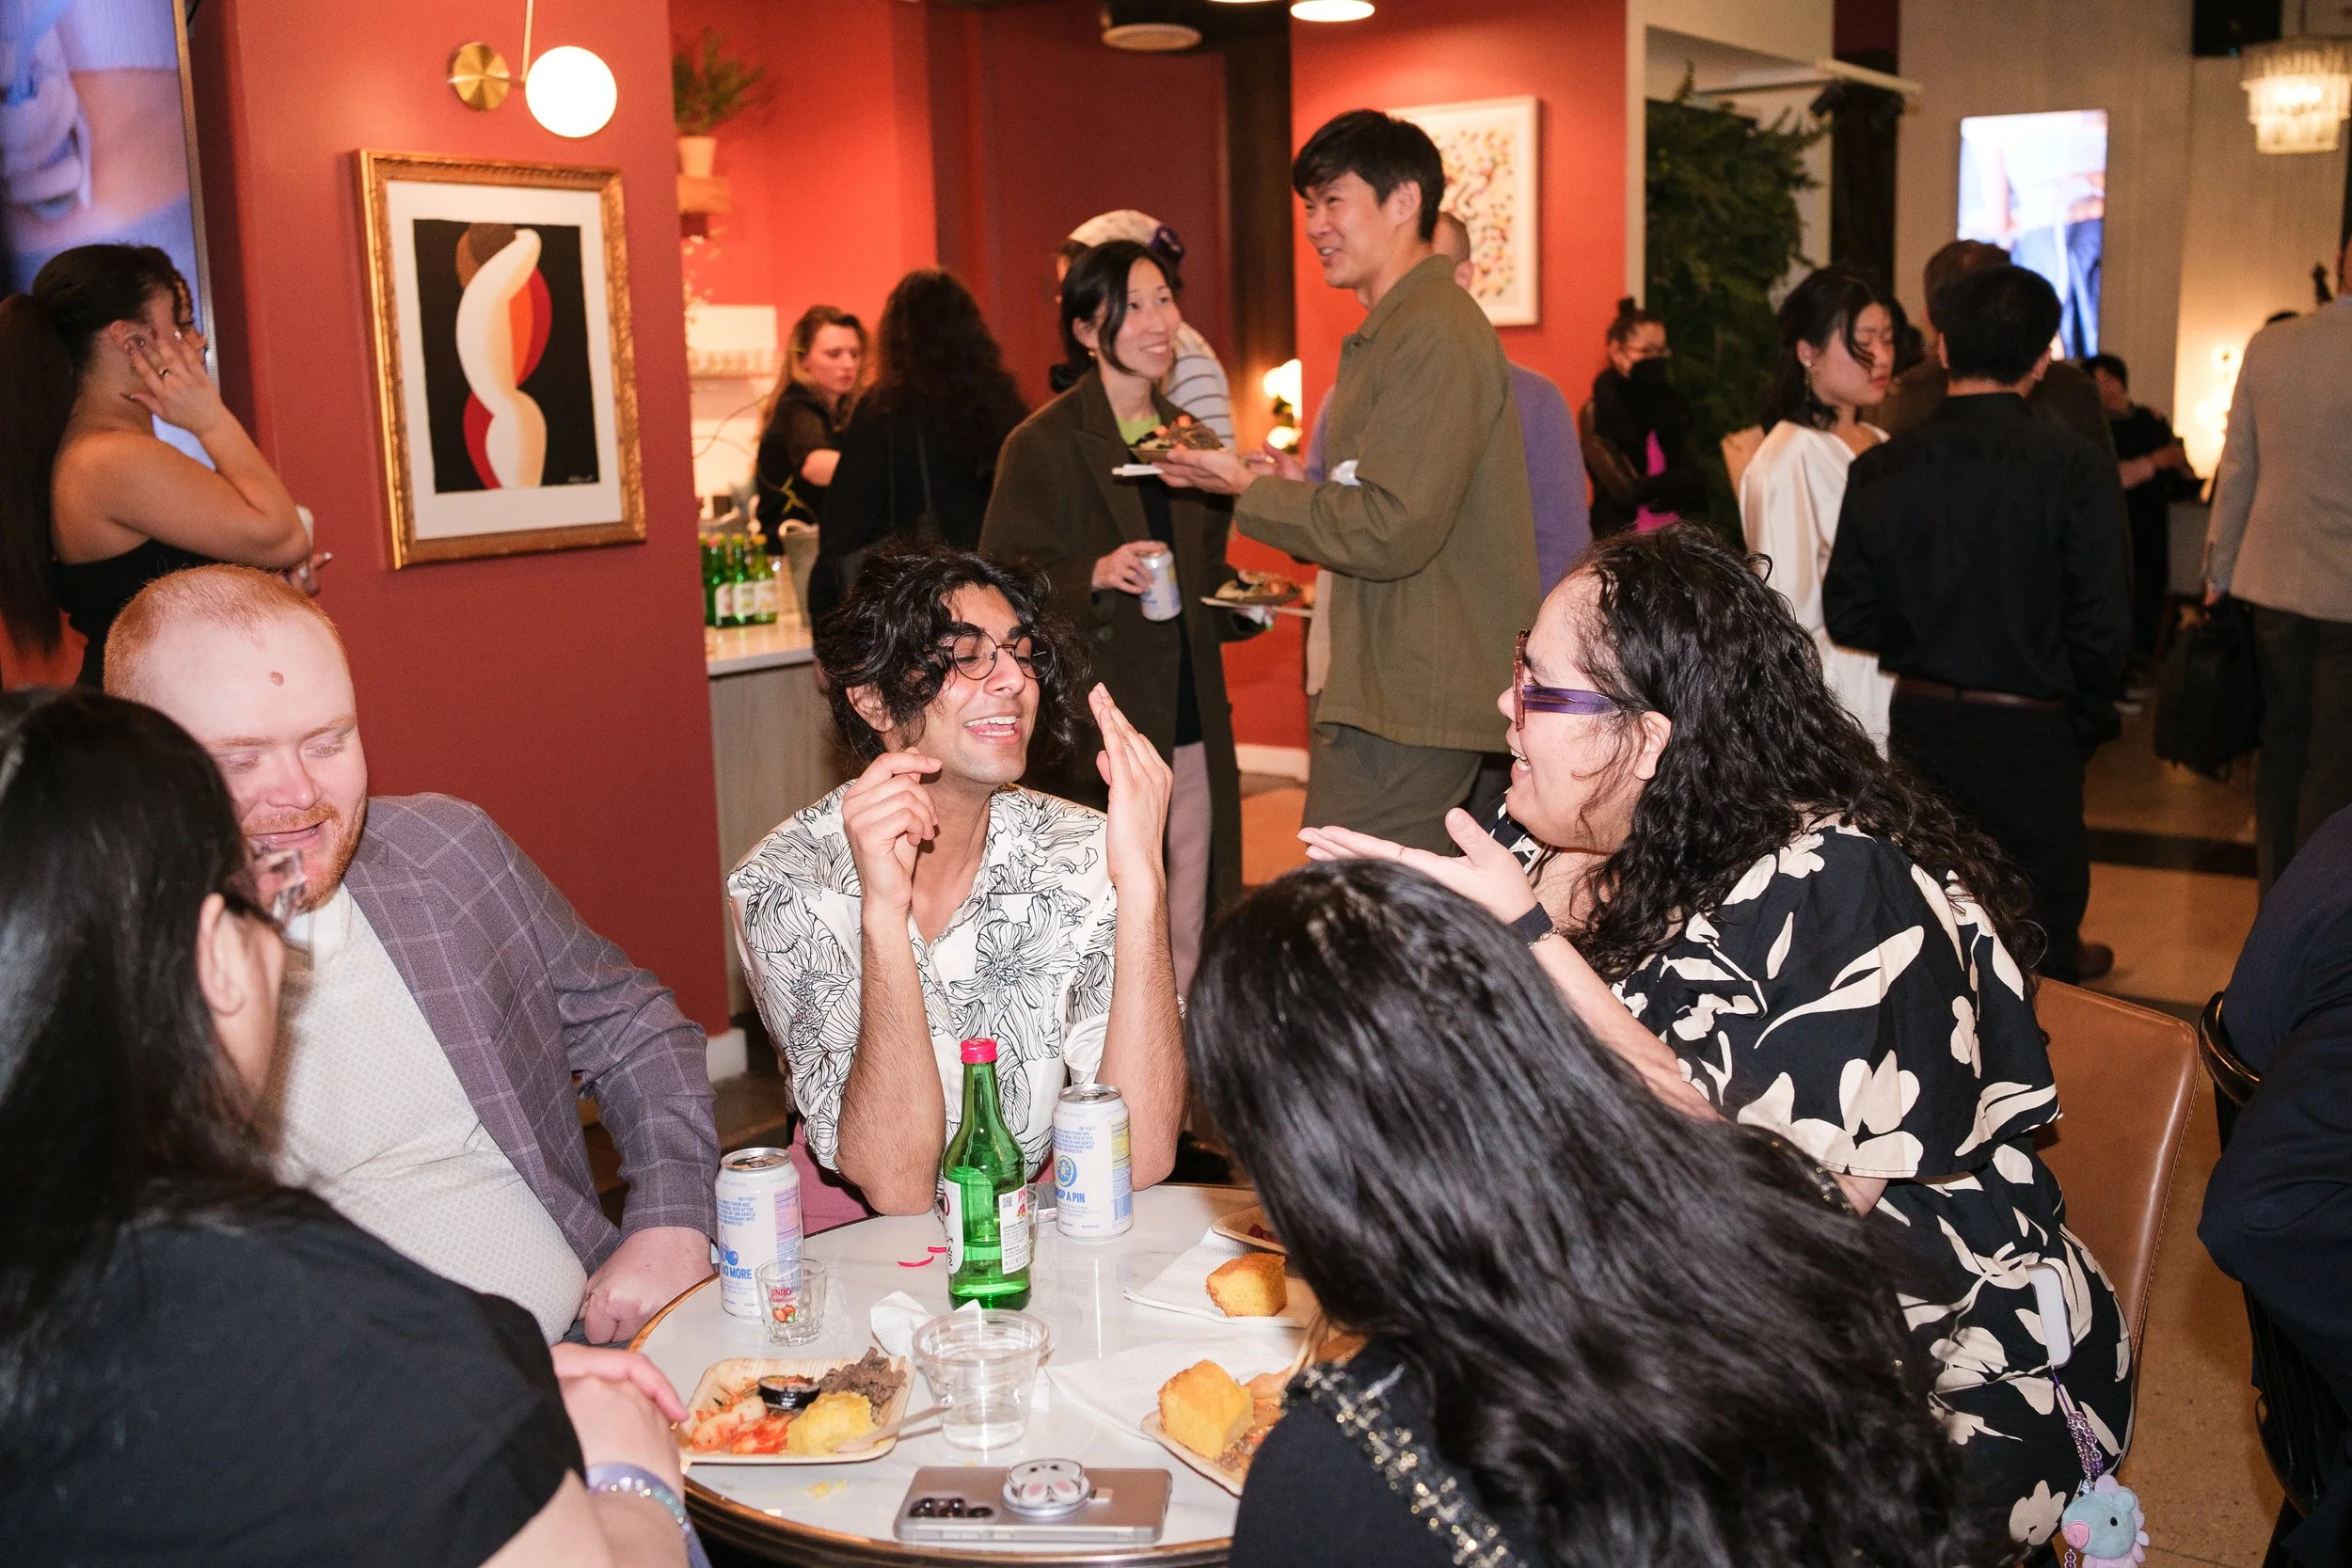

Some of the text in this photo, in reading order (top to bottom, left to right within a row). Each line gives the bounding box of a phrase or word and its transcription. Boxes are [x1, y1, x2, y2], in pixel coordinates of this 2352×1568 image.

[1066, 1191, 1072, 1202] A
[1072, 1192, 1085, 1203] PIN
[729, 1266, 752, 1279] MORE
[771, 1288, 792, 1297] JINRO
